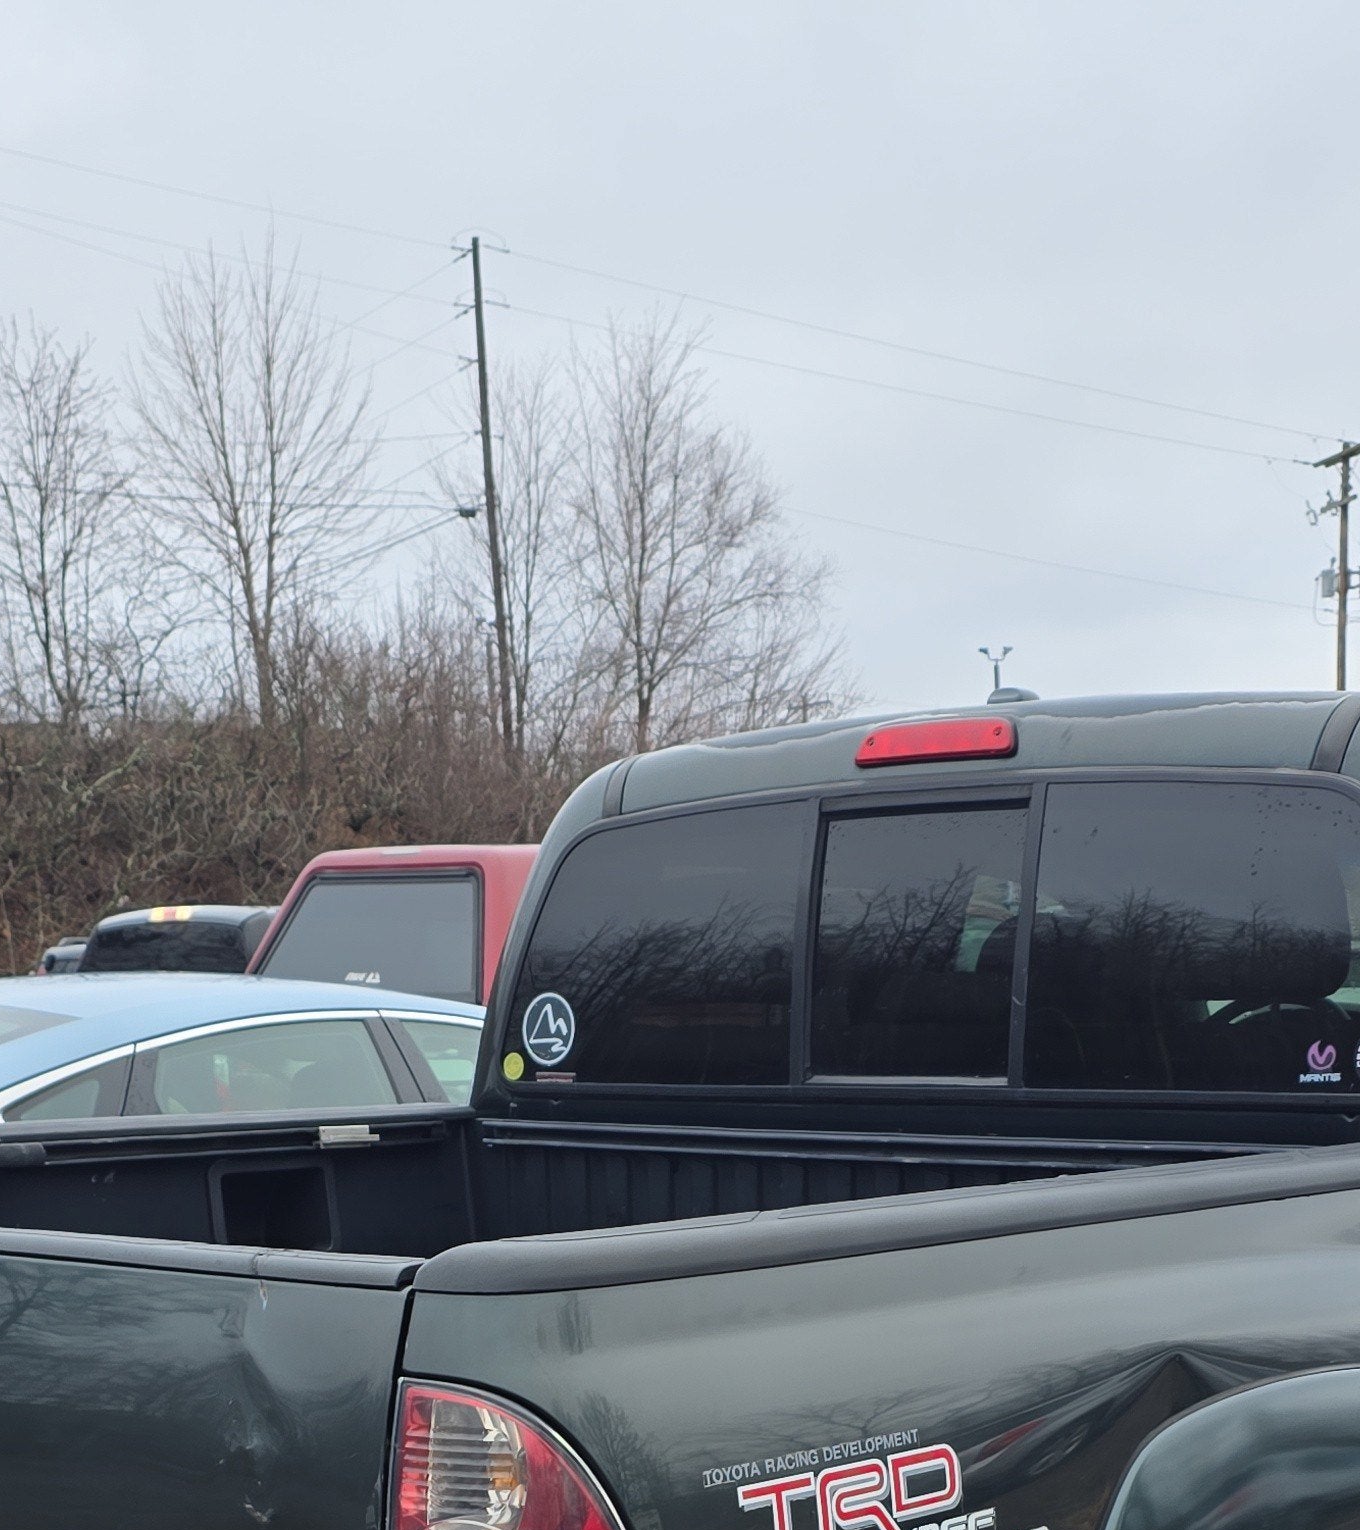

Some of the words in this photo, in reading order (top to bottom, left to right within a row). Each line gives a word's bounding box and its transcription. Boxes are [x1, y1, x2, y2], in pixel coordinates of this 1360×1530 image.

[703, 1460, 762, 1488] TOYOTA
[765, 1449, 819, 1475] RACING
[823, 1428, 919, 1464] DEVELOPMENT
